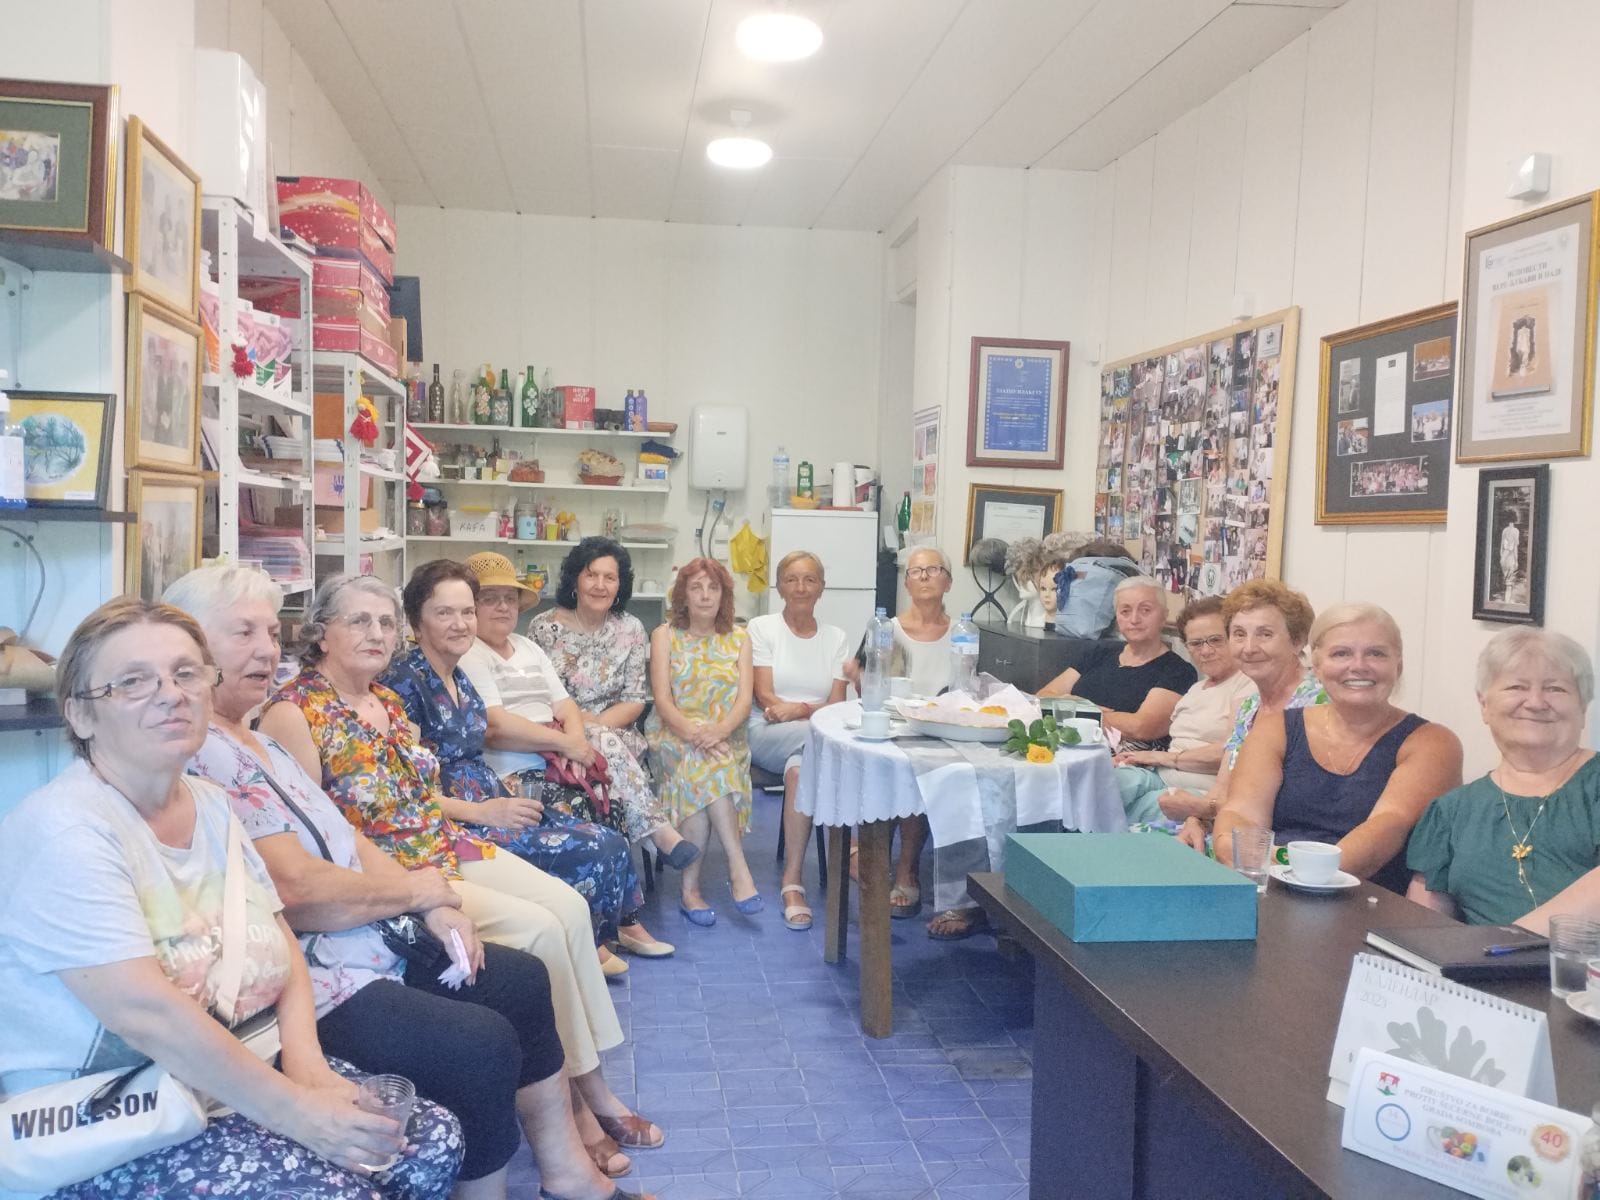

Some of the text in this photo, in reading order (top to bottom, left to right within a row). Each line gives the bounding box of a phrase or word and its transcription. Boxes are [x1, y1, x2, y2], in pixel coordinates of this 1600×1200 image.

[1404, 1089, 1436, 1104] PROTIV
[1466, 1100, 1478, 1110] ZA
[1540, 1131, 1562, 1149] 40
